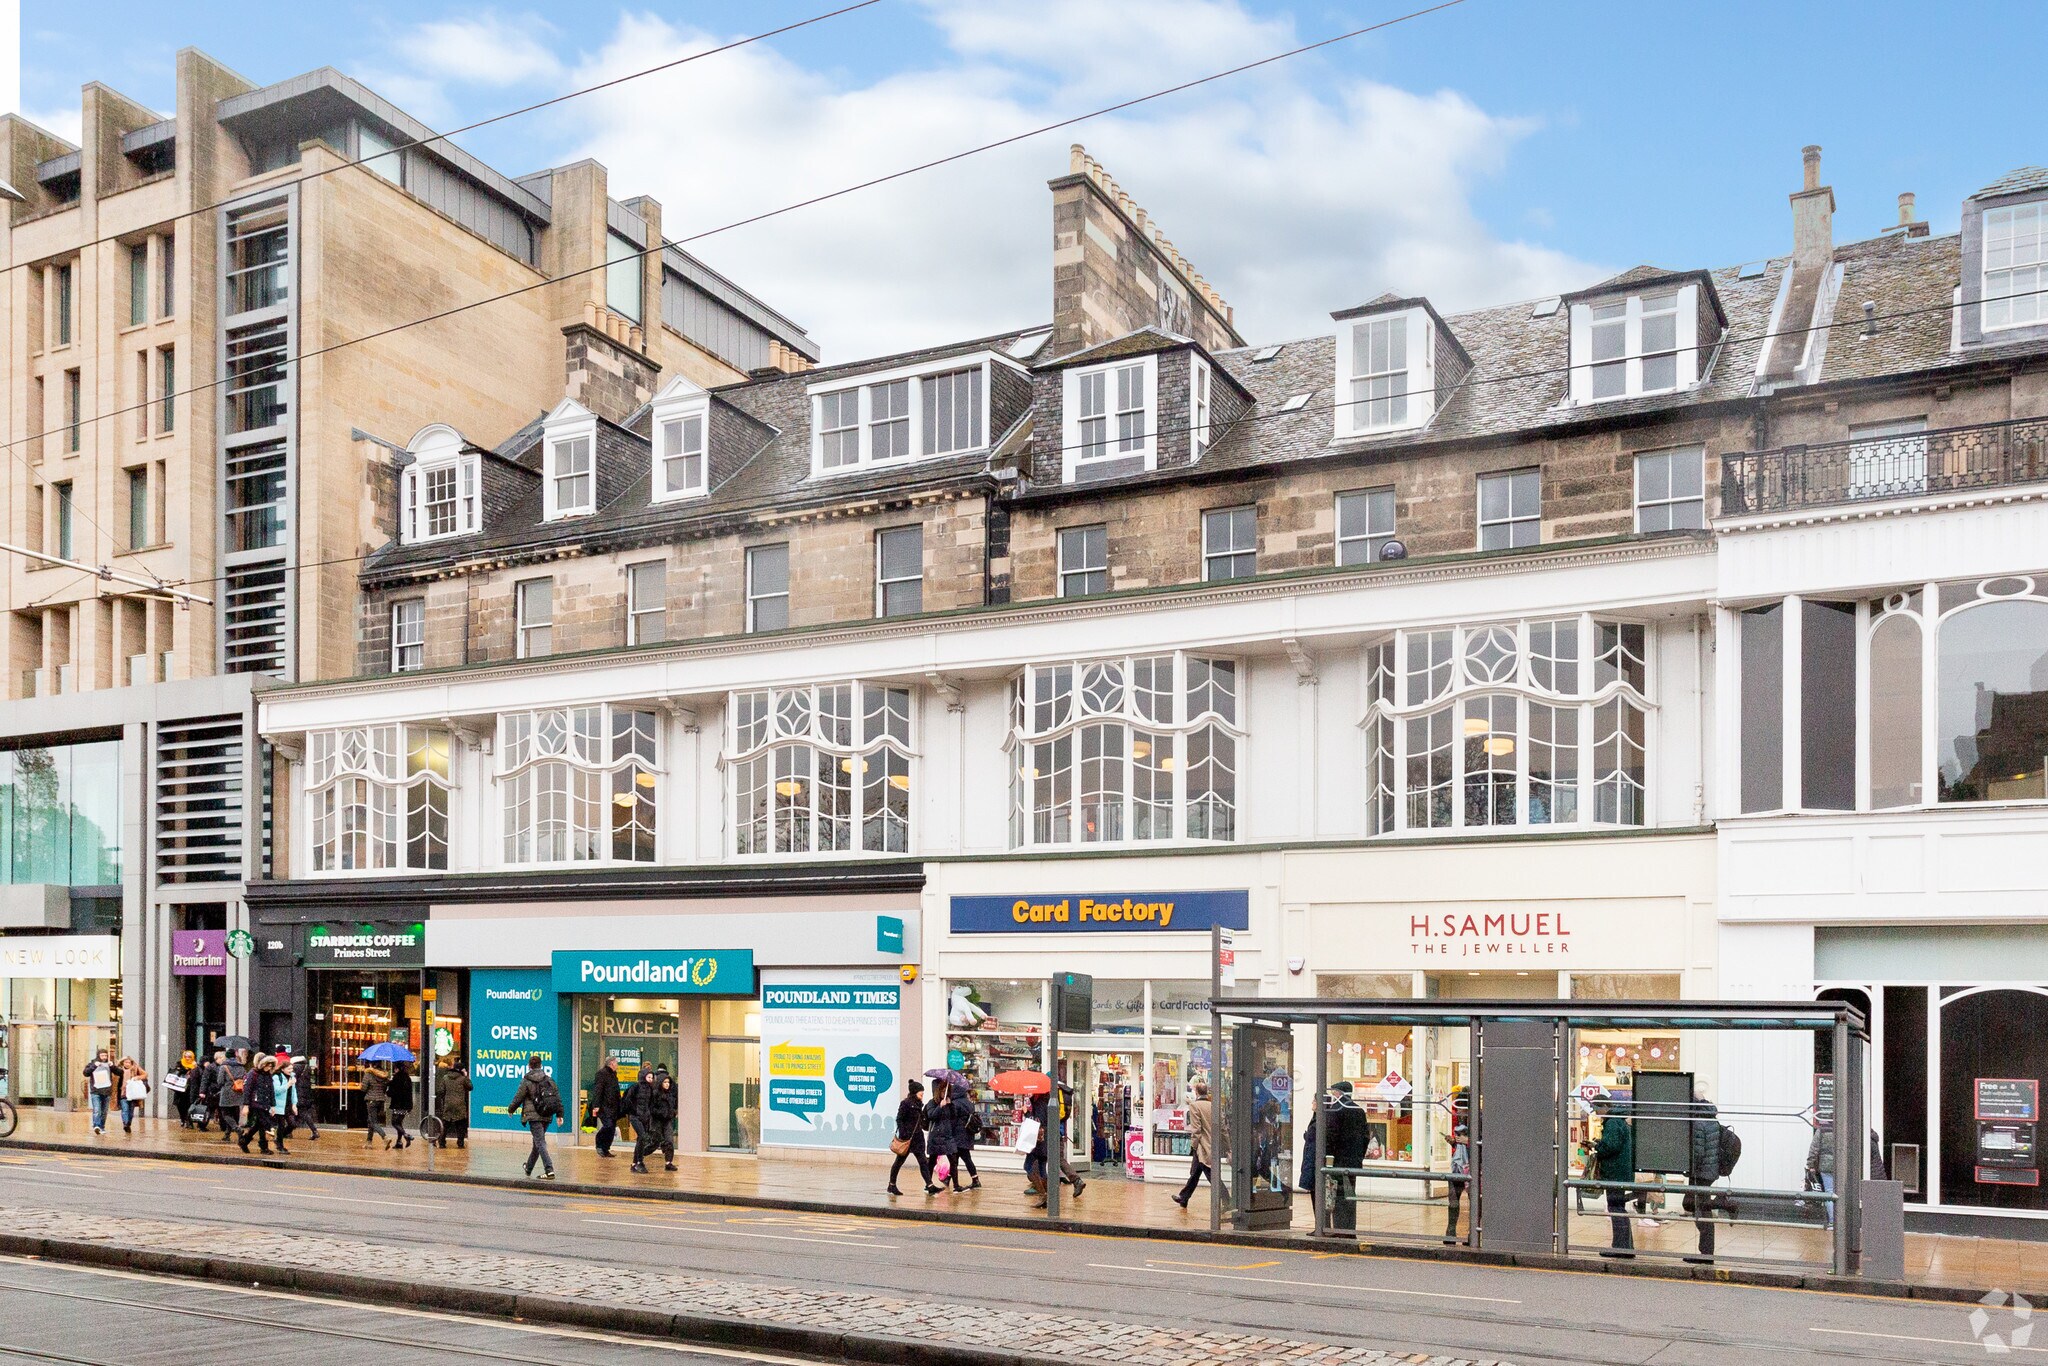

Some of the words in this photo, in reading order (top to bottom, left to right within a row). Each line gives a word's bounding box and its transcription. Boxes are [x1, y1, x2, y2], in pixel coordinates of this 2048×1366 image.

[1012, 899, 1069, 922] Card
[1079, 898, 1174, 926] Factory
[1411, 913, 1571, 937] H.SAMUEL
[310, 935, 373, 947] STARBUCKS
[374, 934, 416, 946] COFFEE
[334, 948, 364, 958] Princes
[365, 947, 391, 958] Street
[1411, 944, 1447, 954] THE
[1463, 943, 1569, 956] JEWELLER
[5, 949, 44, 965] NEW
[54, 949, 104, 965] LOOK
[174, 954, 206, 966] Premier
[208, 954, 223, 966] Inn
[581, 959, 688, 983] Poundland
[486, 988, 531, 1000] Poundland
[766, 990, 851, 1004] POUNDLAND
[853, 991, 898, 1005] TIMES
[491, 1025, 538, 1041] OPENS
[477, 1049, 528, 1060] SATURDAY
[476, 1063, 554, 1079] NOVEMR
[1980, 1082, 1998, 1090] Free
